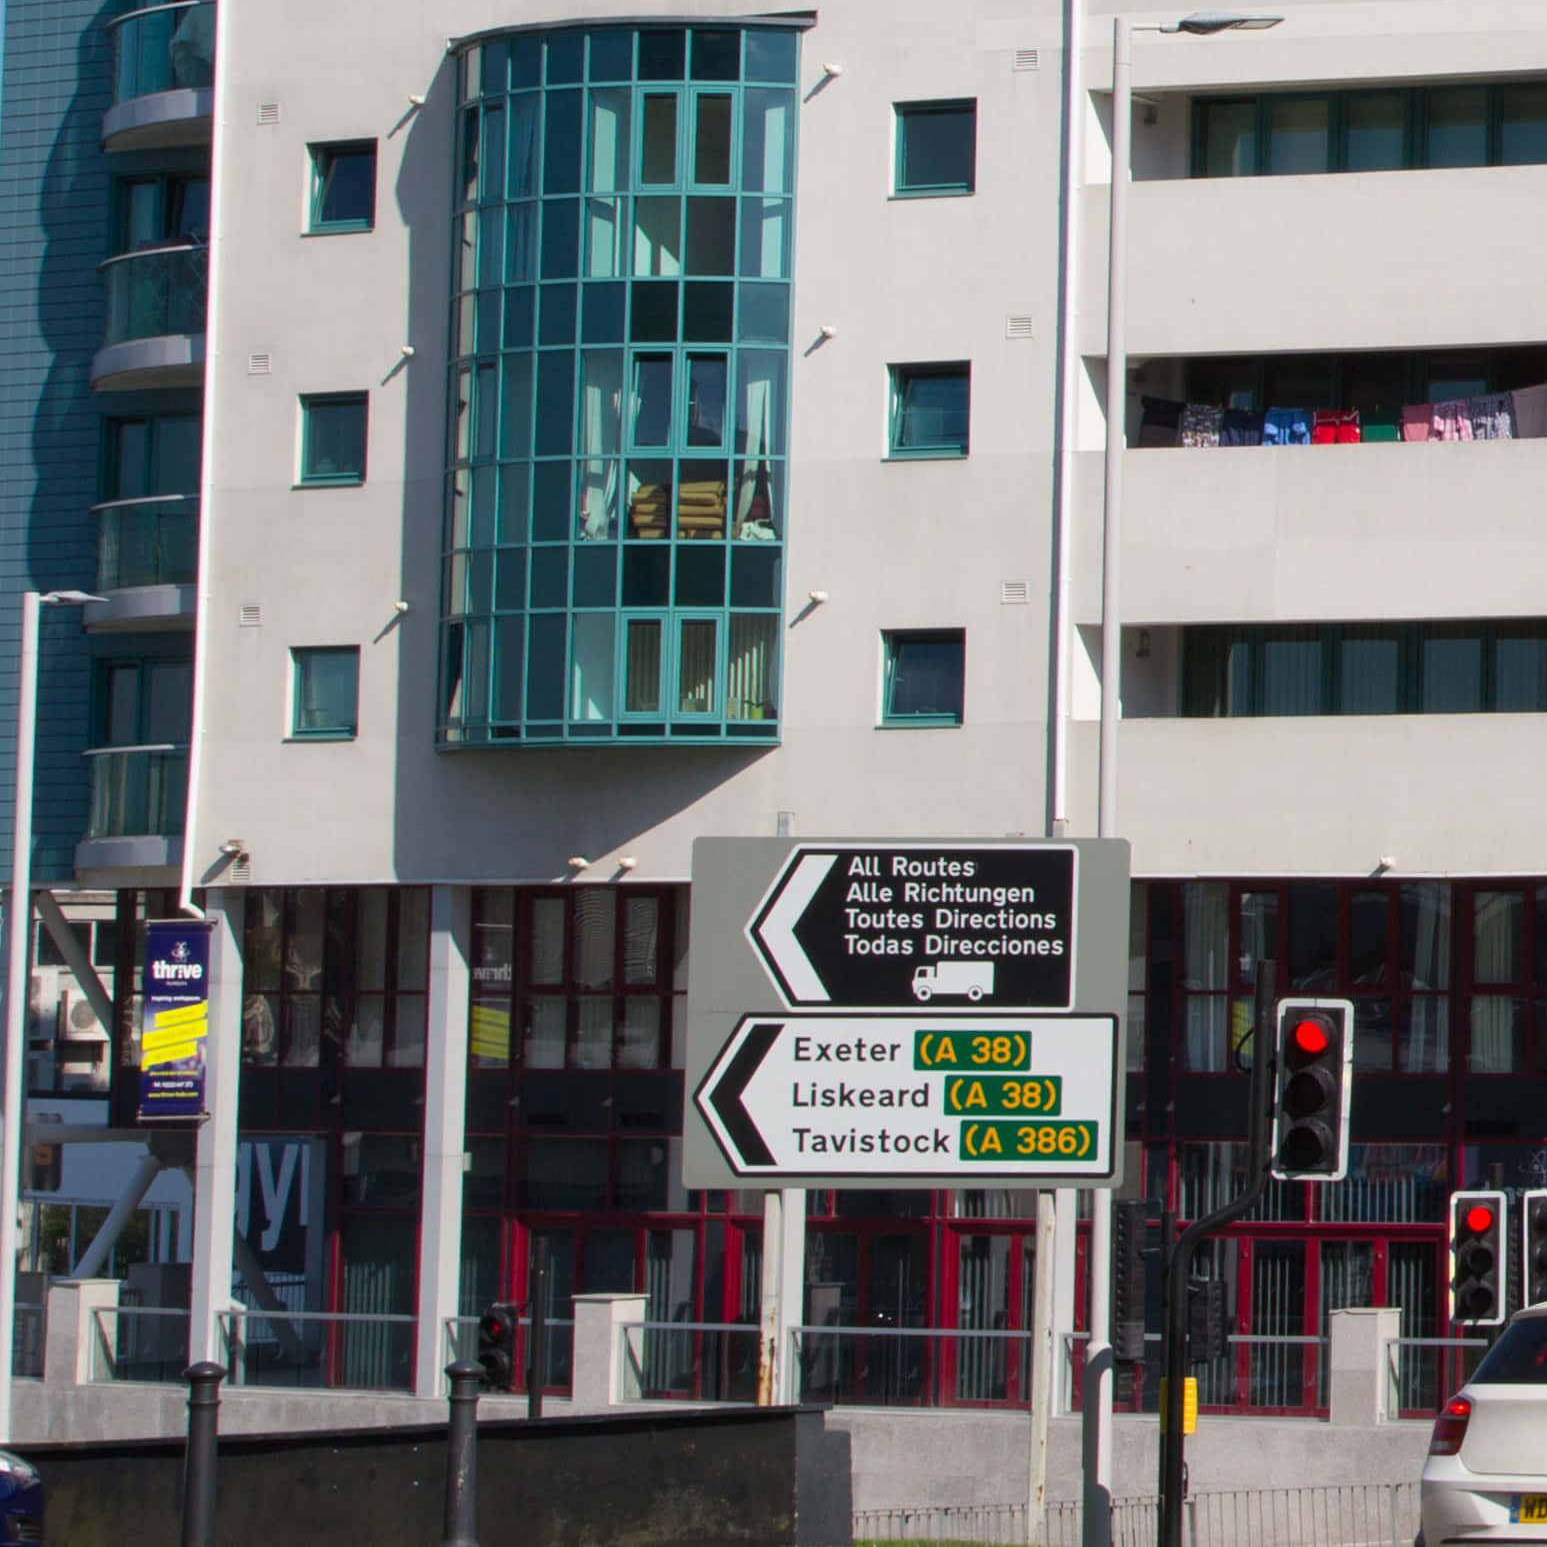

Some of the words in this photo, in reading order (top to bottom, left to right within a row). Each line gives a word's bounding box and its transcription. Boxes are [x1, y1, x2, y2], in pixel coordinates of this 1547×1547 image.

[848, 856, 881, 876] All
[892, 856, 976, 877] Routes
[846, 882, 893, 903] Alle
[904, 882, 1035, 907] Richtungen
[845, 908, 924, 929] Toutes
[935, 908, 1057, 929] Directions
[844, 934, 914, 955] Todas
[925, 934, 1064, 955] Direcciones
[793, 1037, 901, 1062] Exeter
[920, 1034, 957, 1065] (A
[971, 1034, 1026, 1065] 38)
[792, 1082, 929, 1107] Liskeard
[950, 1079, 987, 1110] (A
[1002, 1079, 1057, 1110] 38)
[792, 1128, 950, 1153] Tavistock
[966, 1124, 1002, 1156] (A
[1017, 1124, 1091, 1156] 386)
